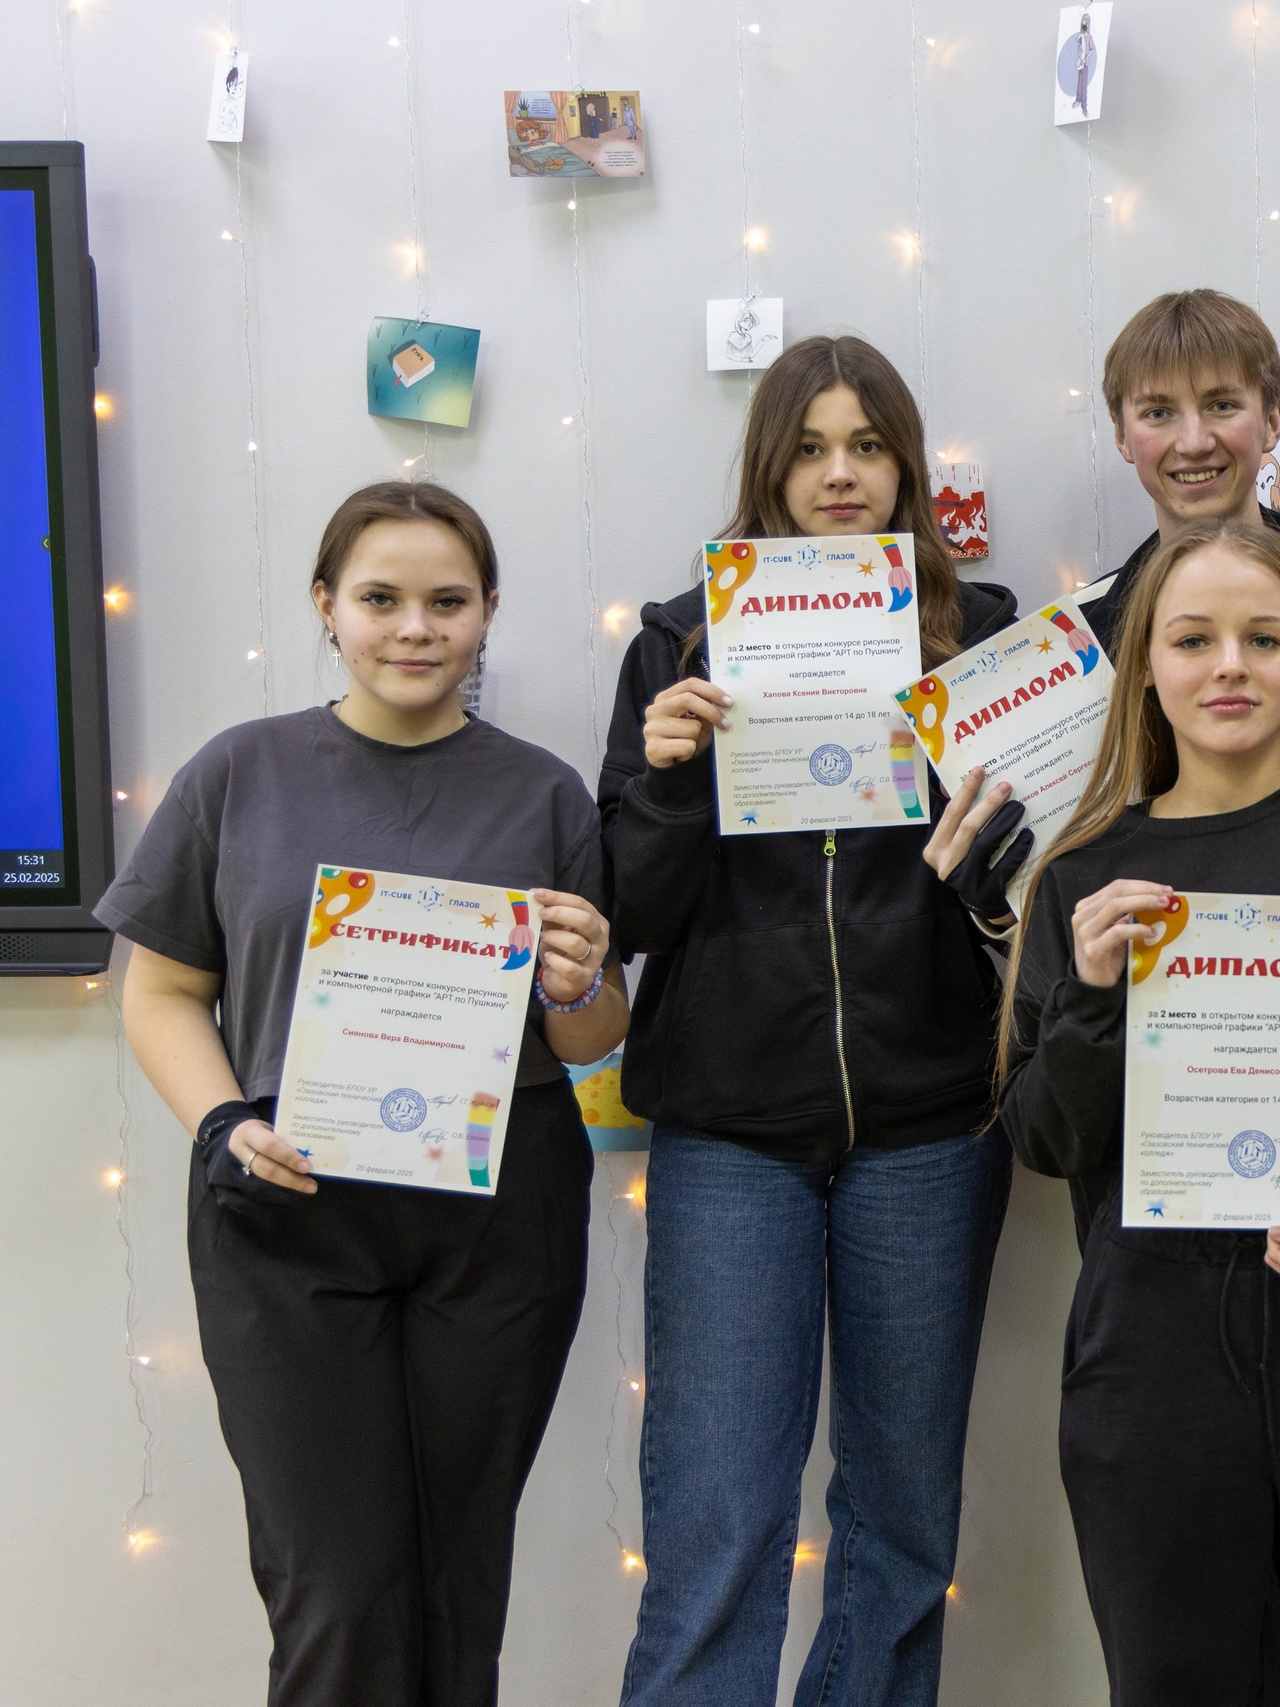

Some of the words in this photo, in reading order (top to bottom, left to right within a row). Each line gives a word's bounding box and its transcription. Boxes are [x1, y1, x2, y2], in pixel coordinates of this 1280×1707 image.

[741, 592, 883, 616] ДИПЛОМ
[738, 644, 744, 652] 2
[782, 642, 823, 650] открытом
[824, 640, 861, 648] конкурсе
[862, 638, 900, 647] рисунков
[1004, 638, 1030, 656] ГЛАЗОВ
[734, 651, 796, 662] компьютерной
[797, 650, 831, 660] графики
[789, 670, 846, 679] награждается
[950, 668, 977, 687] IT-CUBE
[821, 688, 867, 696] Викторовна
[955, 661, 1076, 743] ДИПЛОМ
[748, 716, 793, 725] Возрастная
[794, 714, 833, 722] категория
[855, 712, 866, 720] до
[867, 710, 876, 718] 18
[981, 758, 998, 770] есто
[1005, 733, 1041, 757] открытом
[1041, 715, 1074, 736] конкурсе
[1074, 696, 1108, 720] рисунков
[1022, 738, 1053, 759] графики
[1069, 723, 1080, 732] по
[1023, 749, 1074, 780] награждается
[773, 780, 817, 790] руководителя
[1040, 773, 1068, 793] Алексей
[733, 799, 776, 808] образованию
[1047, 795, 1081, 817] категория
[800, 817, 809, 825] 20
[809, 817, 837, 825] февраля
[17, 855, 44, 865] 15:31
[4, 873, 60, 883] 25.02.2025
[380, 890, 412, 900] IT-CUBE
[449, 899, 480, 909] ГЛАЗОВ
[1196, 912, 1228, 921] IT-CUBE
[330, 922, 516, 959] СЕТРИФИКАТ
[333, 970, 369, 981] участие
[380, 976, 424, 987] открытом
[426, 983, 466, 993] конкурсе
[467, 988, 508, 999] рисунков
[326, 980, 393, 994] компьютерной
[394, 988, 431, 999] графики
[454, 996, 466, 1004] по
[380, 1008, 442, 1021] награждается
[1160, 1009, 1166, 1018] 2
[1168, 1011, 1197, 1019] место
[1209, 1012, 1254, 1021] открытом
[1155, 1022, 1223, 1031] компьютерной
[1224, 1023, 1263, 1032] графики
[342, 1028, 379, 1039] Сиянова
[380, 1033, 401, 1043] Вера
[403, 1035, 465, 1050] Владимировна
[1214, 1046, 1277, 1054] награждается
[1187, 1065, 1228, 1075] Осетрова
[1230, 1066, 1247, 1074] Ева
